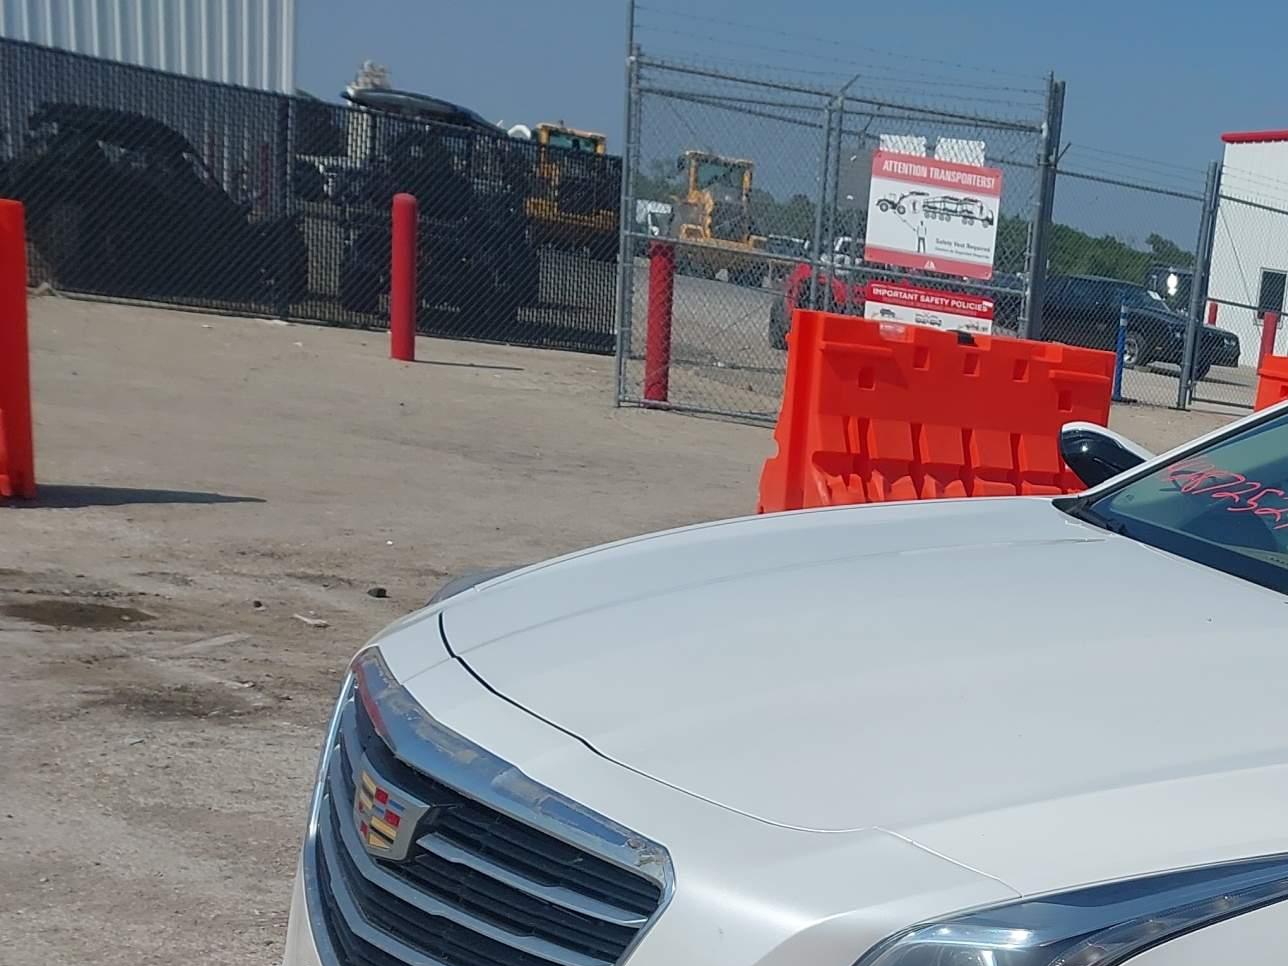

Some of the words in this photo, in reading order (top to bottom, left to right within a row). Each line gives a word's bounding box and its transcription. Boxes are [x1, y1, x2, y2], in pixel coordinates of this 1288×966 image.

[882, 160, 928, 178] ATTENTION
[929, 167, 995, 189] TRANSPORTERS!
[872, 287, 919, 301] IMPORTANT
[919, 294, 950, 306] SAFETY
[950, 300, 989, 312] POLICIES
